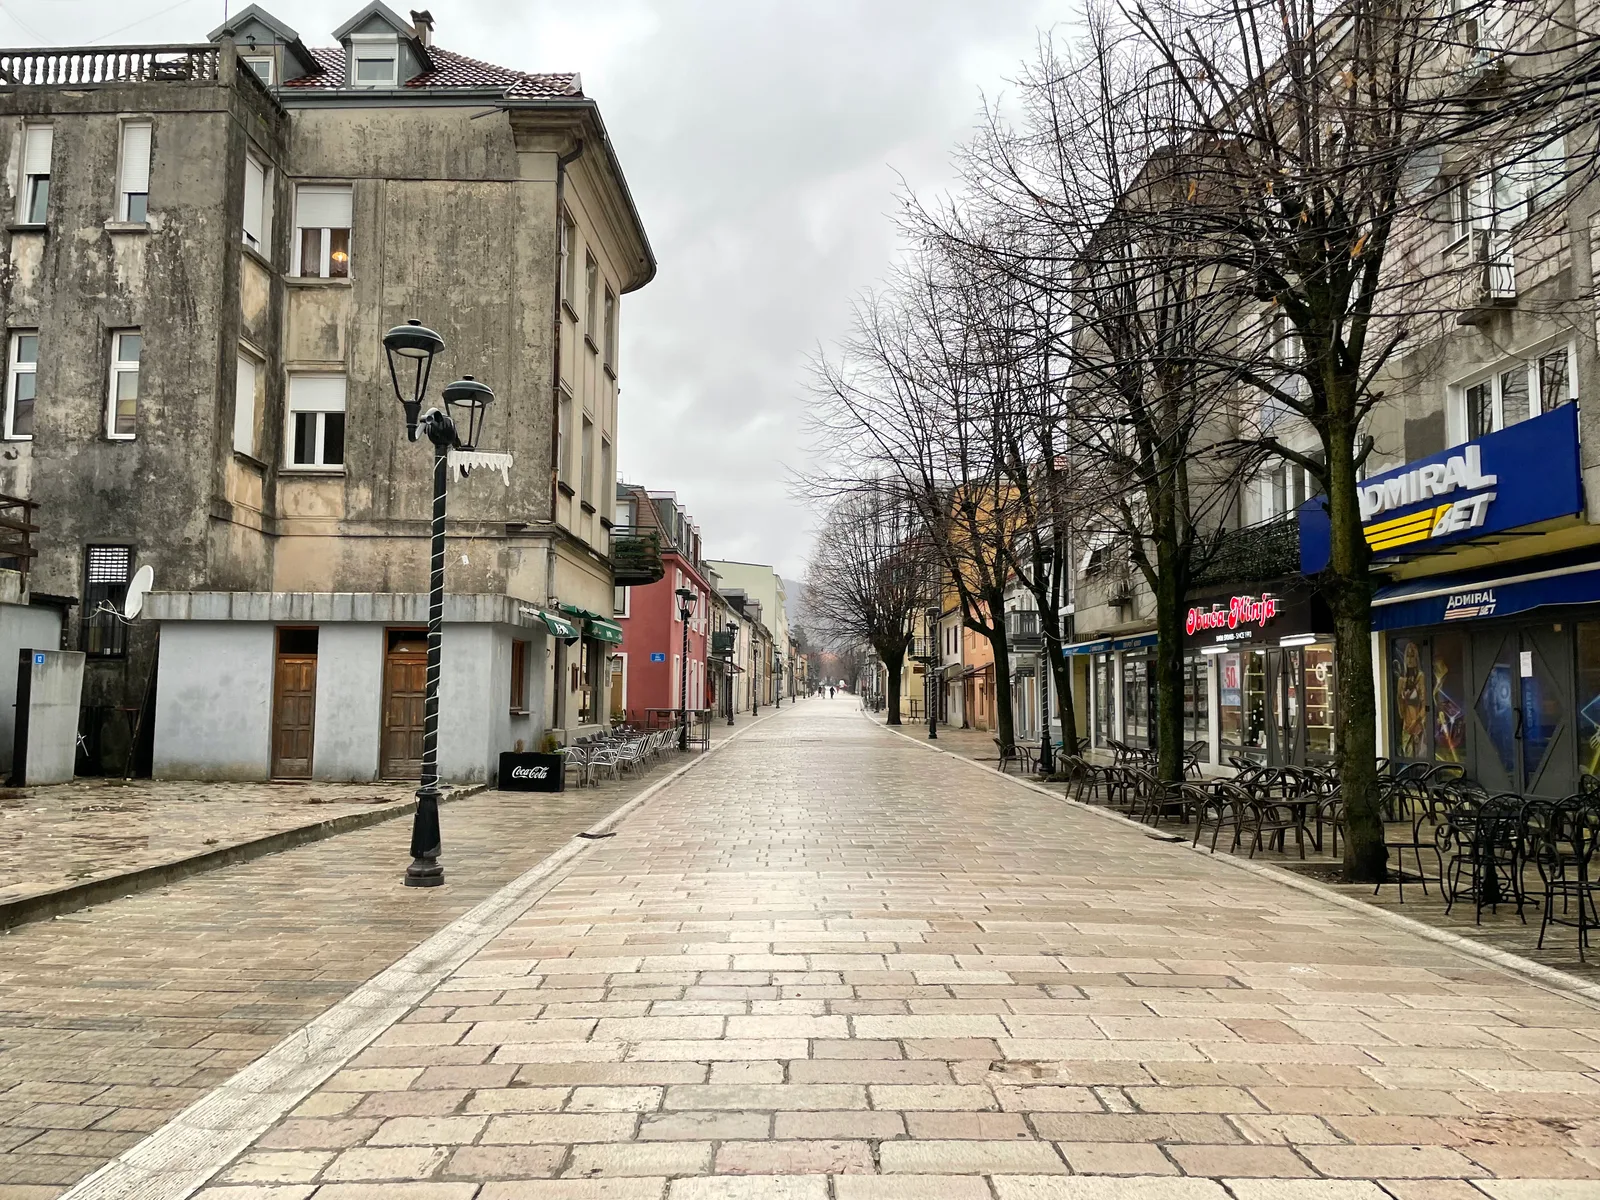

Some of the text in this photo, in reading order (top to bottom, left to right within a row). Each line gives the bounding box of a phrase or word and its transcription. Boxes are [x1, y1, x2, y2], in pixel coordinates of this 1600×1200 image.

[1430, 492, 1497, 538] BET
[1446, 589, 1497, 610] ADMIRAL
[1479, 604, 1496, 616] BET
[1186, 594, 1275, 635] Obuća Minja
[1225, 667, 1235, 688] 50
[512, 766, 550, 779] Coca-Cola
